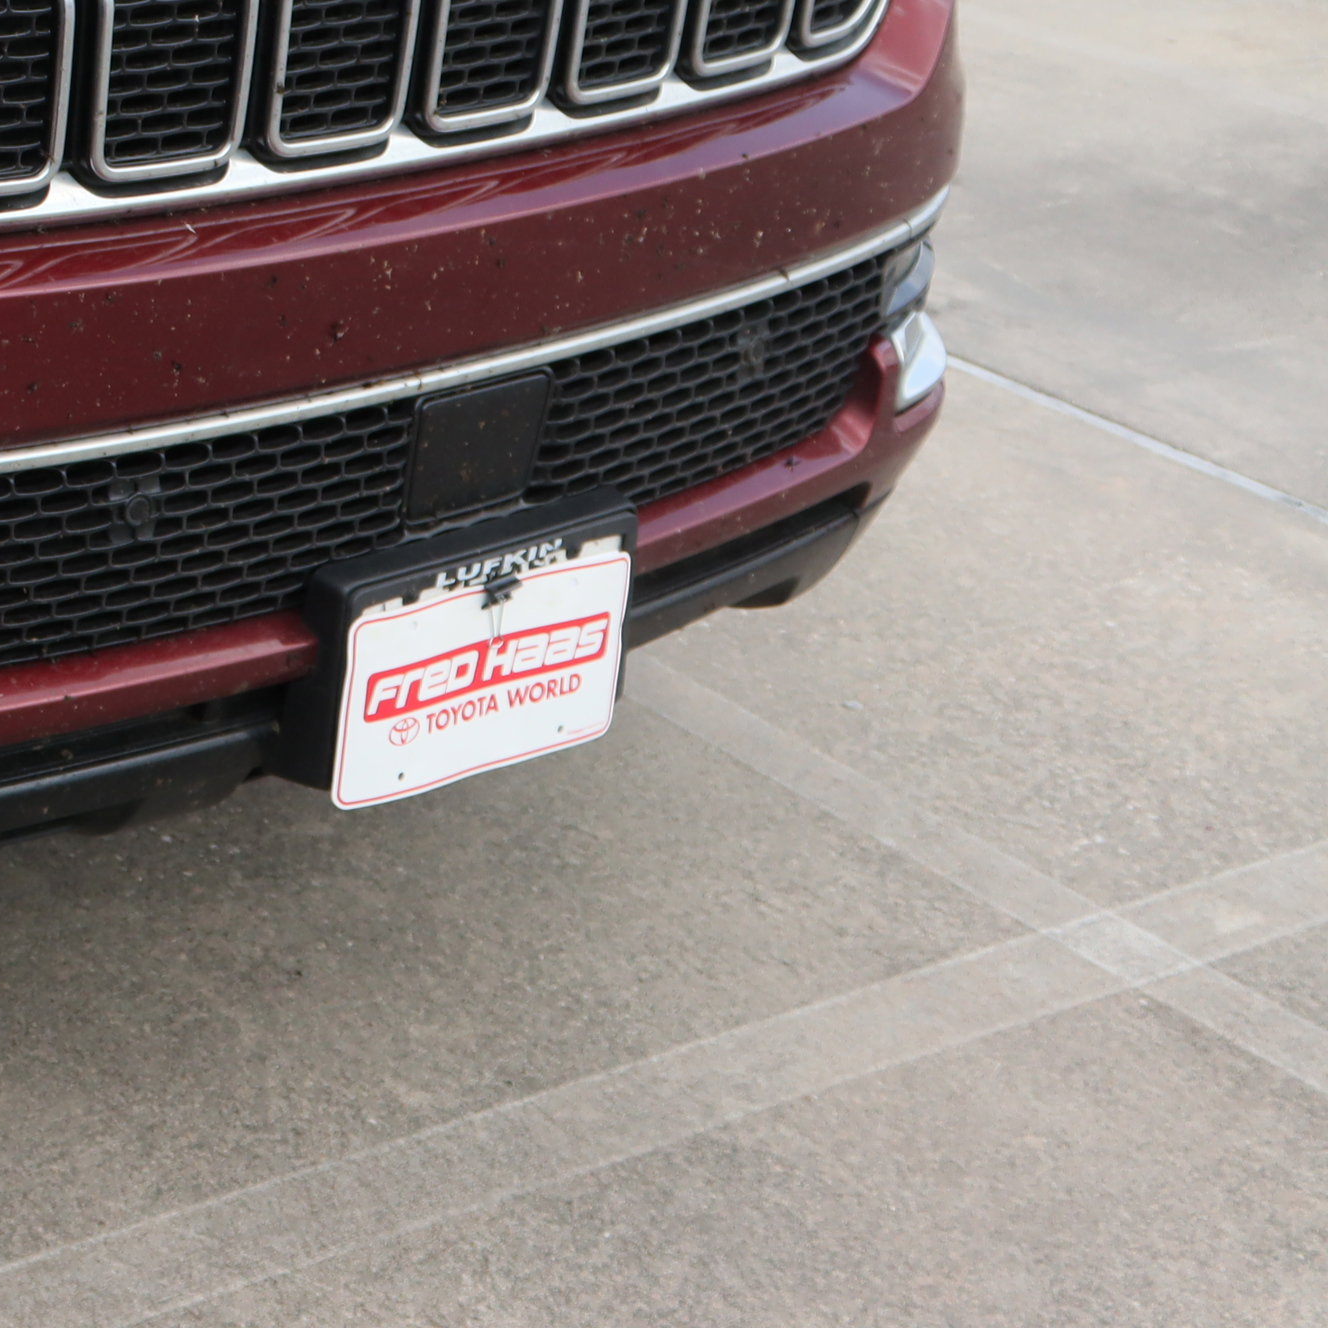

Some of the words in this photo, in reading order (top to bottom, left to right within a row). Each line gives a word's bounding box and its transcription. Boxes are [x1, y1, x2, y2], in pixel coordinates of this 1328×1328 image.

[435, 538, 563, 589] LUFKIN
[426, 695, 499, 734] TOYOTA
[507, 673, 582, 708] WORLD
